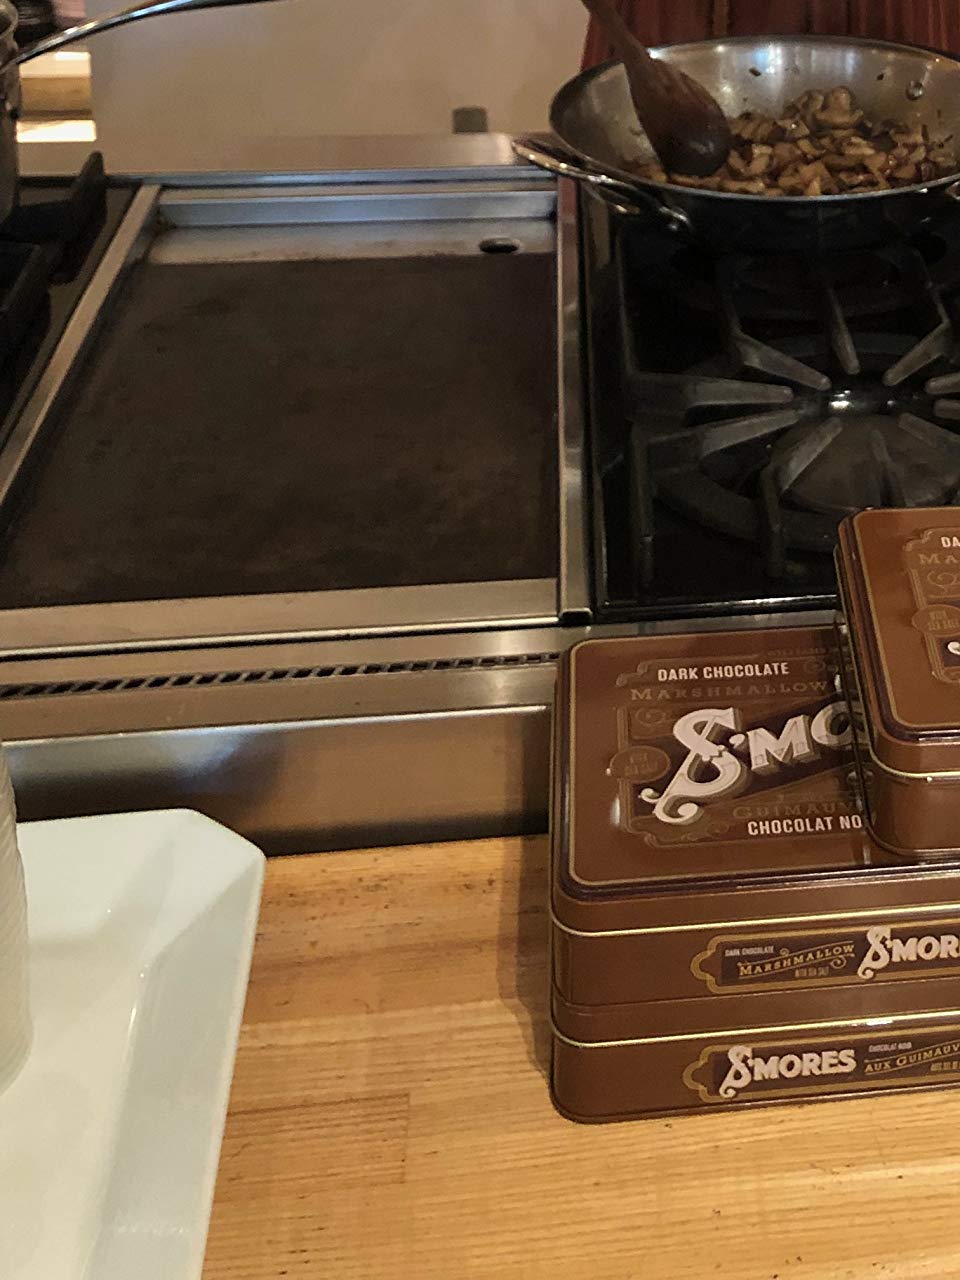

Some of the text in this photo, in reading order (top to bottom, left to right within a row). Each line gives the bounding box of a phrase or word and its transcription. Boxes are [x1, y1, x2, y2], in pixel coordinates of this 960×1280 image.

[657, 662, 790, 682] DARK CHOCOLATE
[630, 680, 828, 701] MARSHMALLOW
[747, 814, 863, 836] CHOCOLAT NO
[724, 946, 741, 958] DARK
[738, 943, 855, 977] MARSHMALLOW
[718, 1044, 858, 1099] S'MORES
[865, 1059, 892, 1074] AUX
